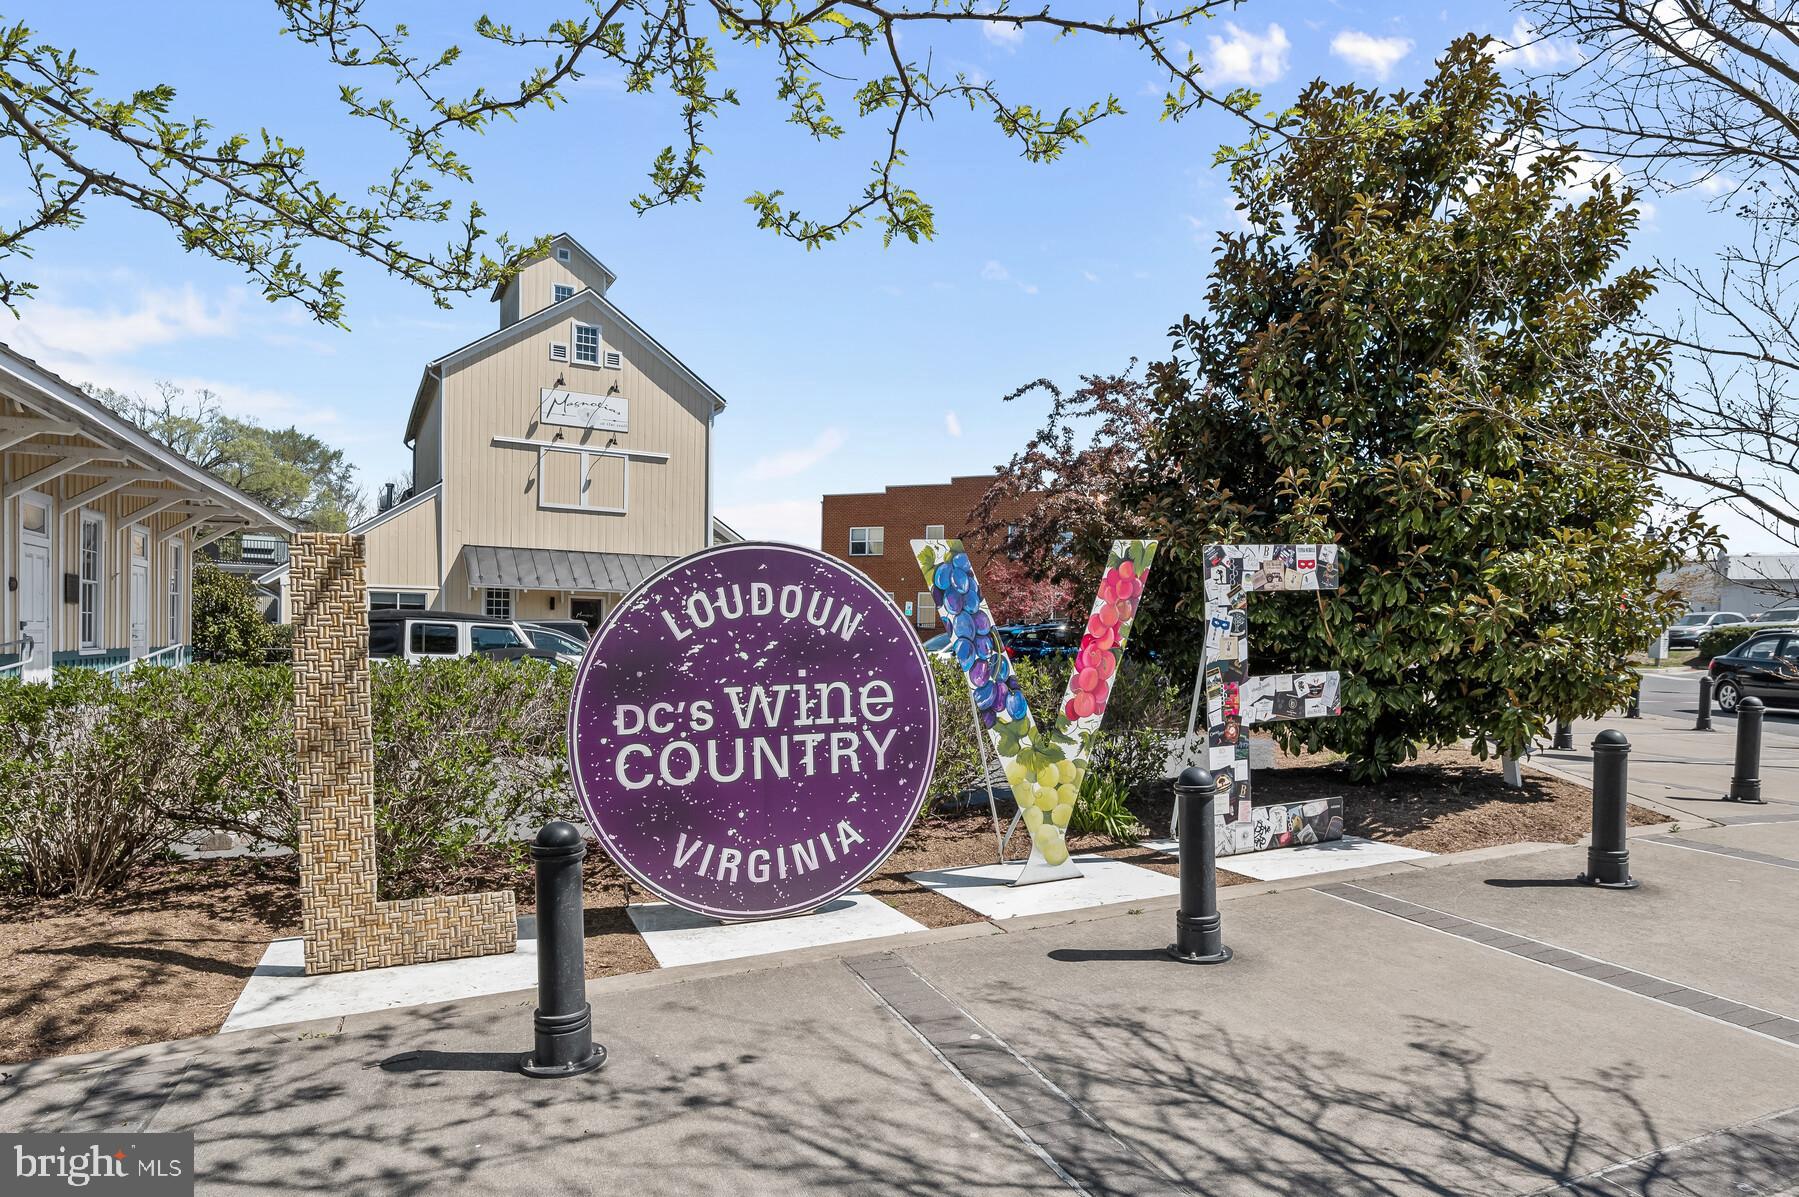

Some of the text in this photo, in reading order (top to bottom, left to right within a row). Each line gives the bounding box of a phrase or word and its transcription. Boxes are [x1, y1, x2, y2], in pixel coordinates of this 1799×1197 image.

[546, 393, 621, 419] Magnolias
[661, 582, 864, 642] LOUDOUN
[724, 669, 894, 729] wine
[615, 729, 898, 790] COUNTRY
[672, 819, 865, 883] VIRGINIA
